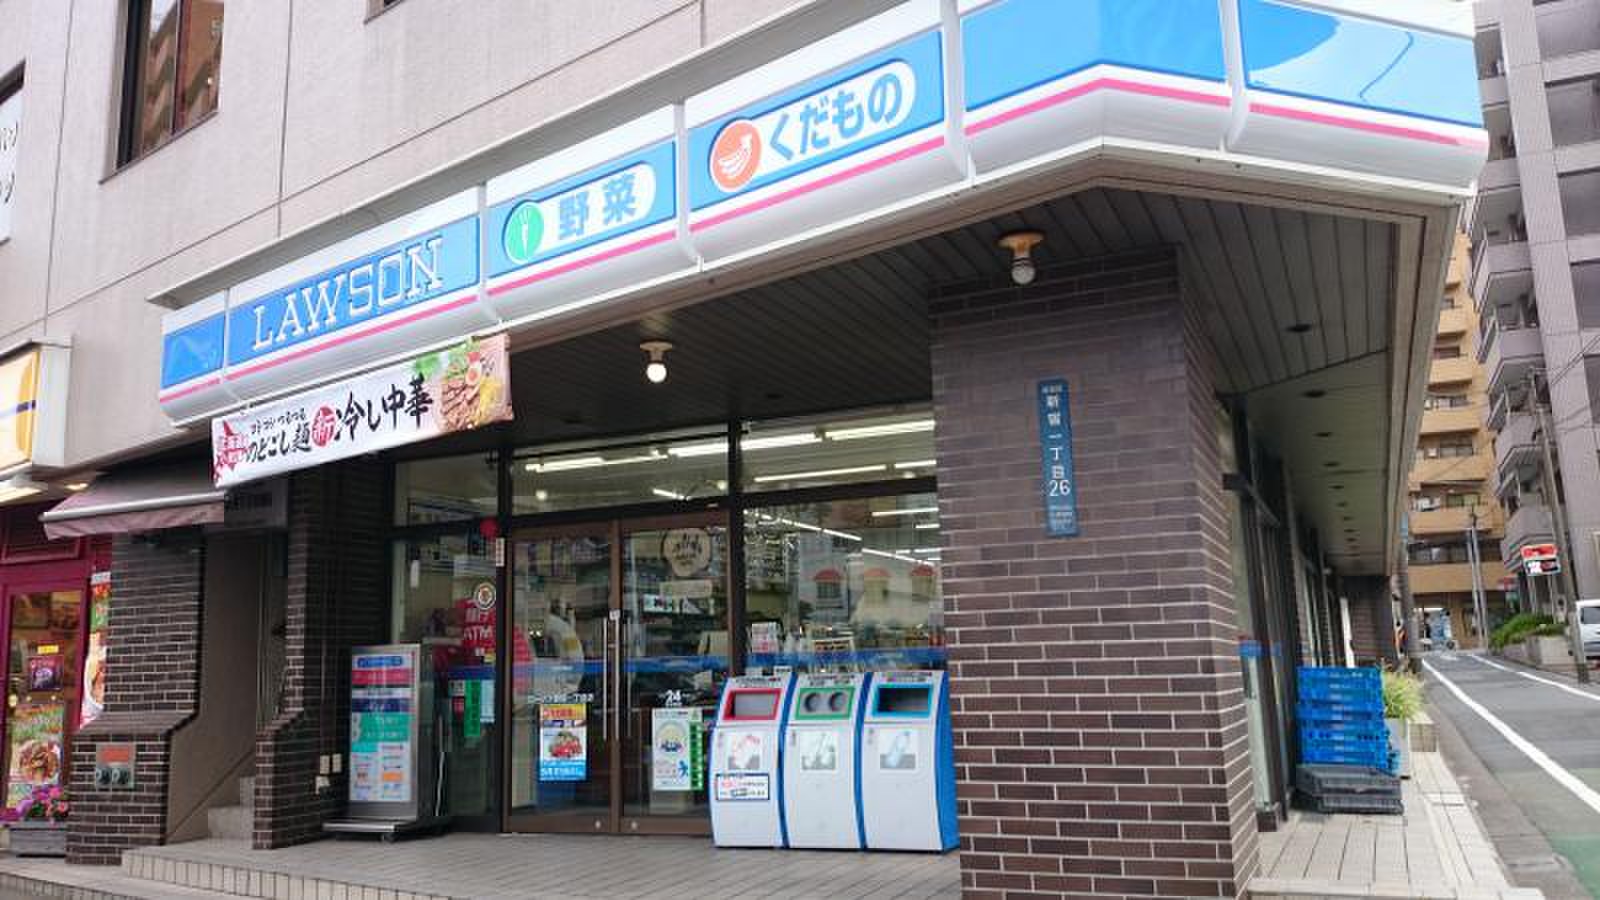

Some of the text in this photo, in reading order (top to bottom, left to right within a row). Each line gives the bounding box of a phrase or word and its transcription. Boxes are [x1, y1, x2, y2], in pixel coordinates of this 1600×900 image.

[768, 73, 903, 162] くだもの
[558, 172, 638, 240] 野菜
[252, 238, 443, 351] LAWSON
[1049, 480, 1071, 497] 26
